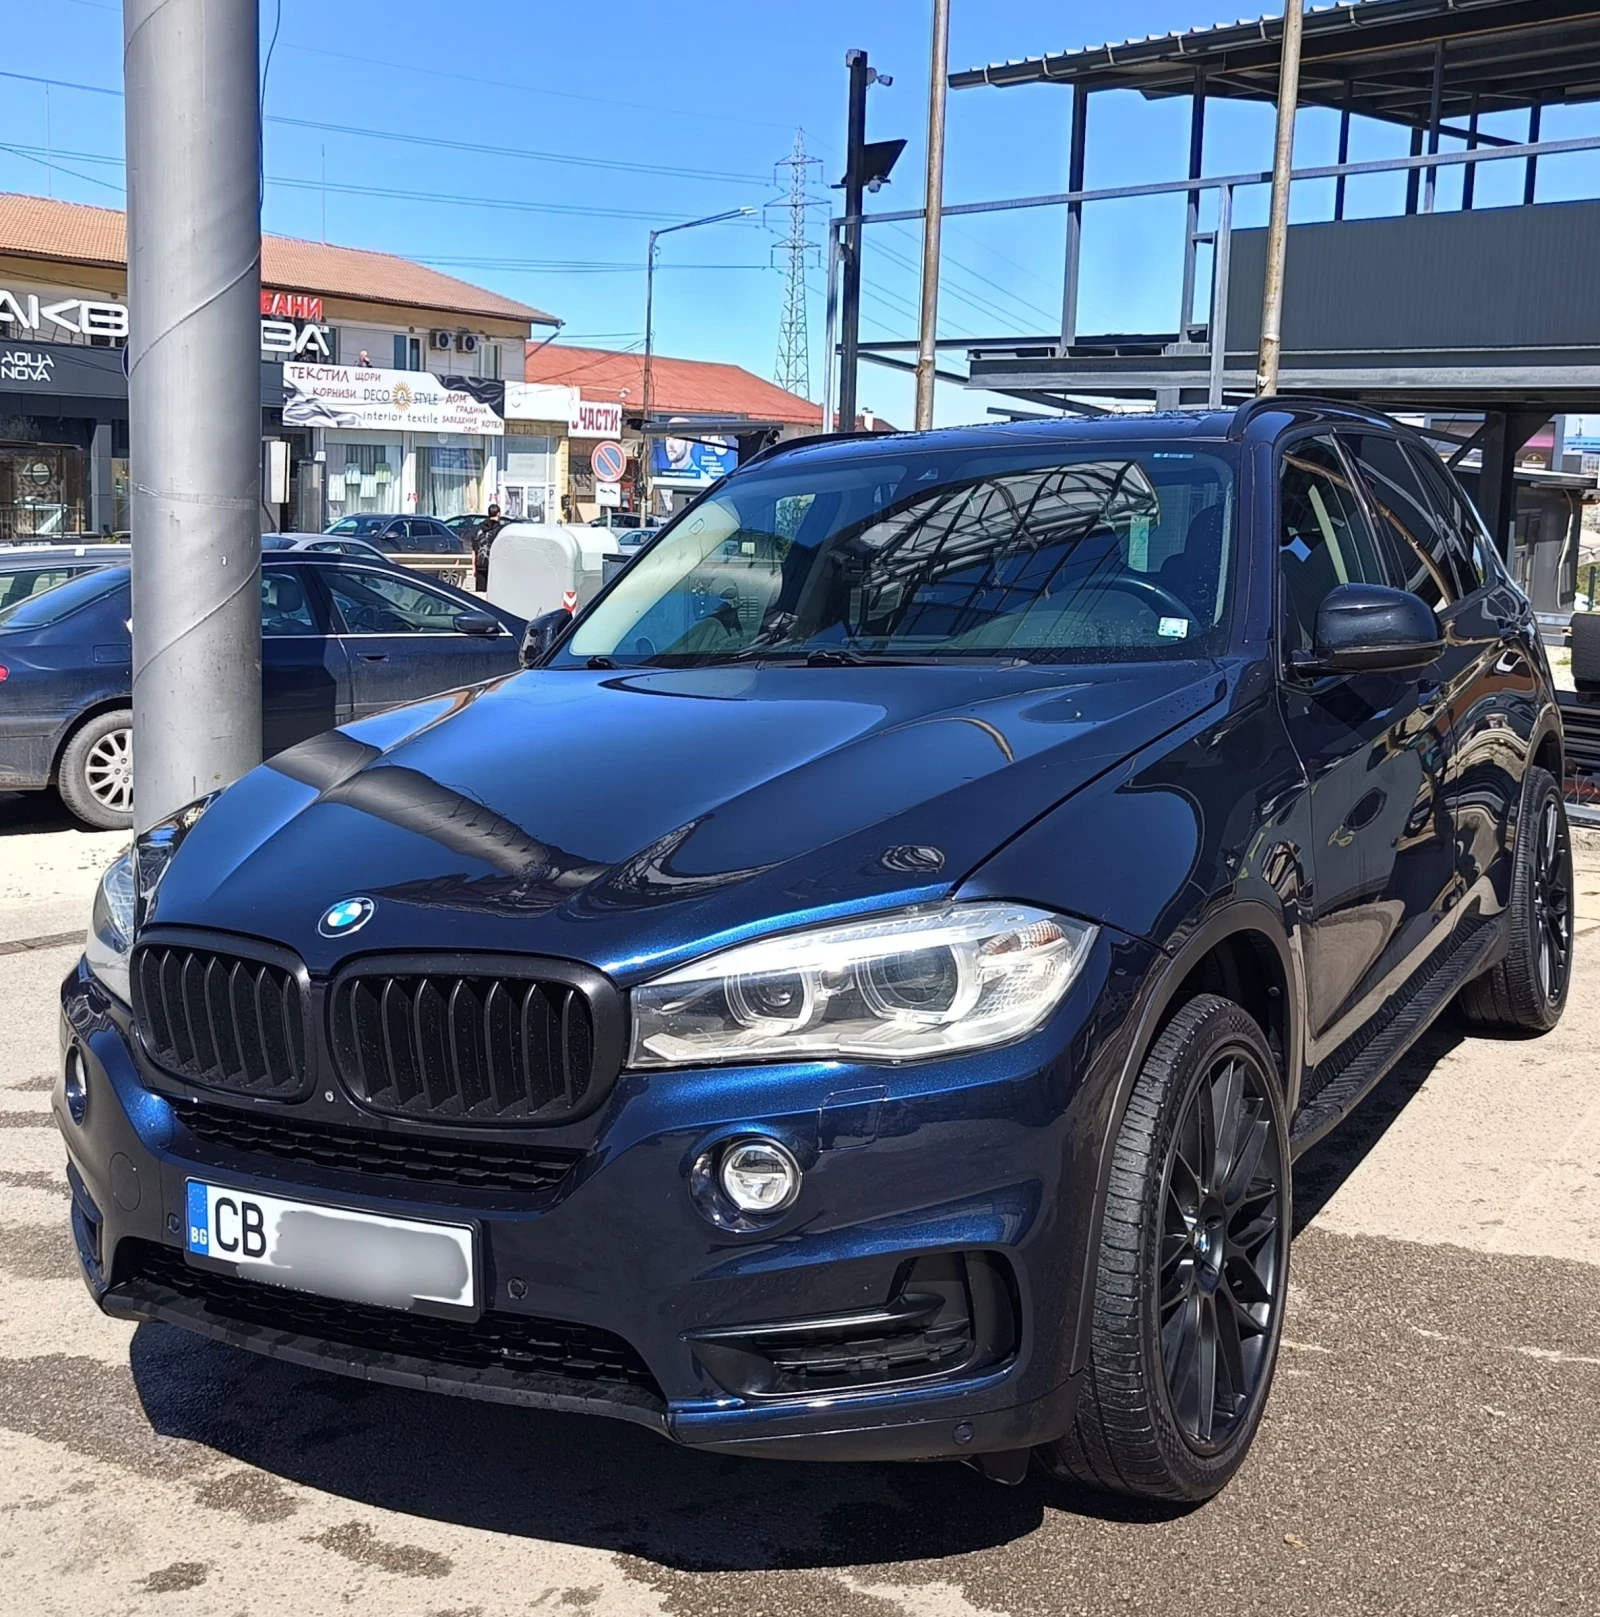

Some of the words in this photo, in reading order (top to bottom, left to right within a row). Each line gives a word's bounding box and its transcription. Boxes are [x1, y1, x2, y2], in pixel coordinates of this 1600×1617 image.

[1, 351, 54, 367] AQUA
[1, 366, 51, 381] NOVA
[290, 366, 349, 383] ТЕКСТИЛ
[355, 372, 381, 382] ЩОРИ
[312, 387, 356, 399] КОРНИЗИ
[364, 388, 390, 401] DECO
[414, 392, 438, 405] STYLE
[445, 393, 467, 404] ДОМ
[363, 411, 402, 421] interior
[408, 413, 438, 424] textile
[455, 406, 487, 415] ГРАДИНА
[442, 415, 477, 424] ЗАВЕДЕНИЕ
[481, 420, 503, 429] ХОТЕЛ
[191, 1227, 207, 1246] BG
